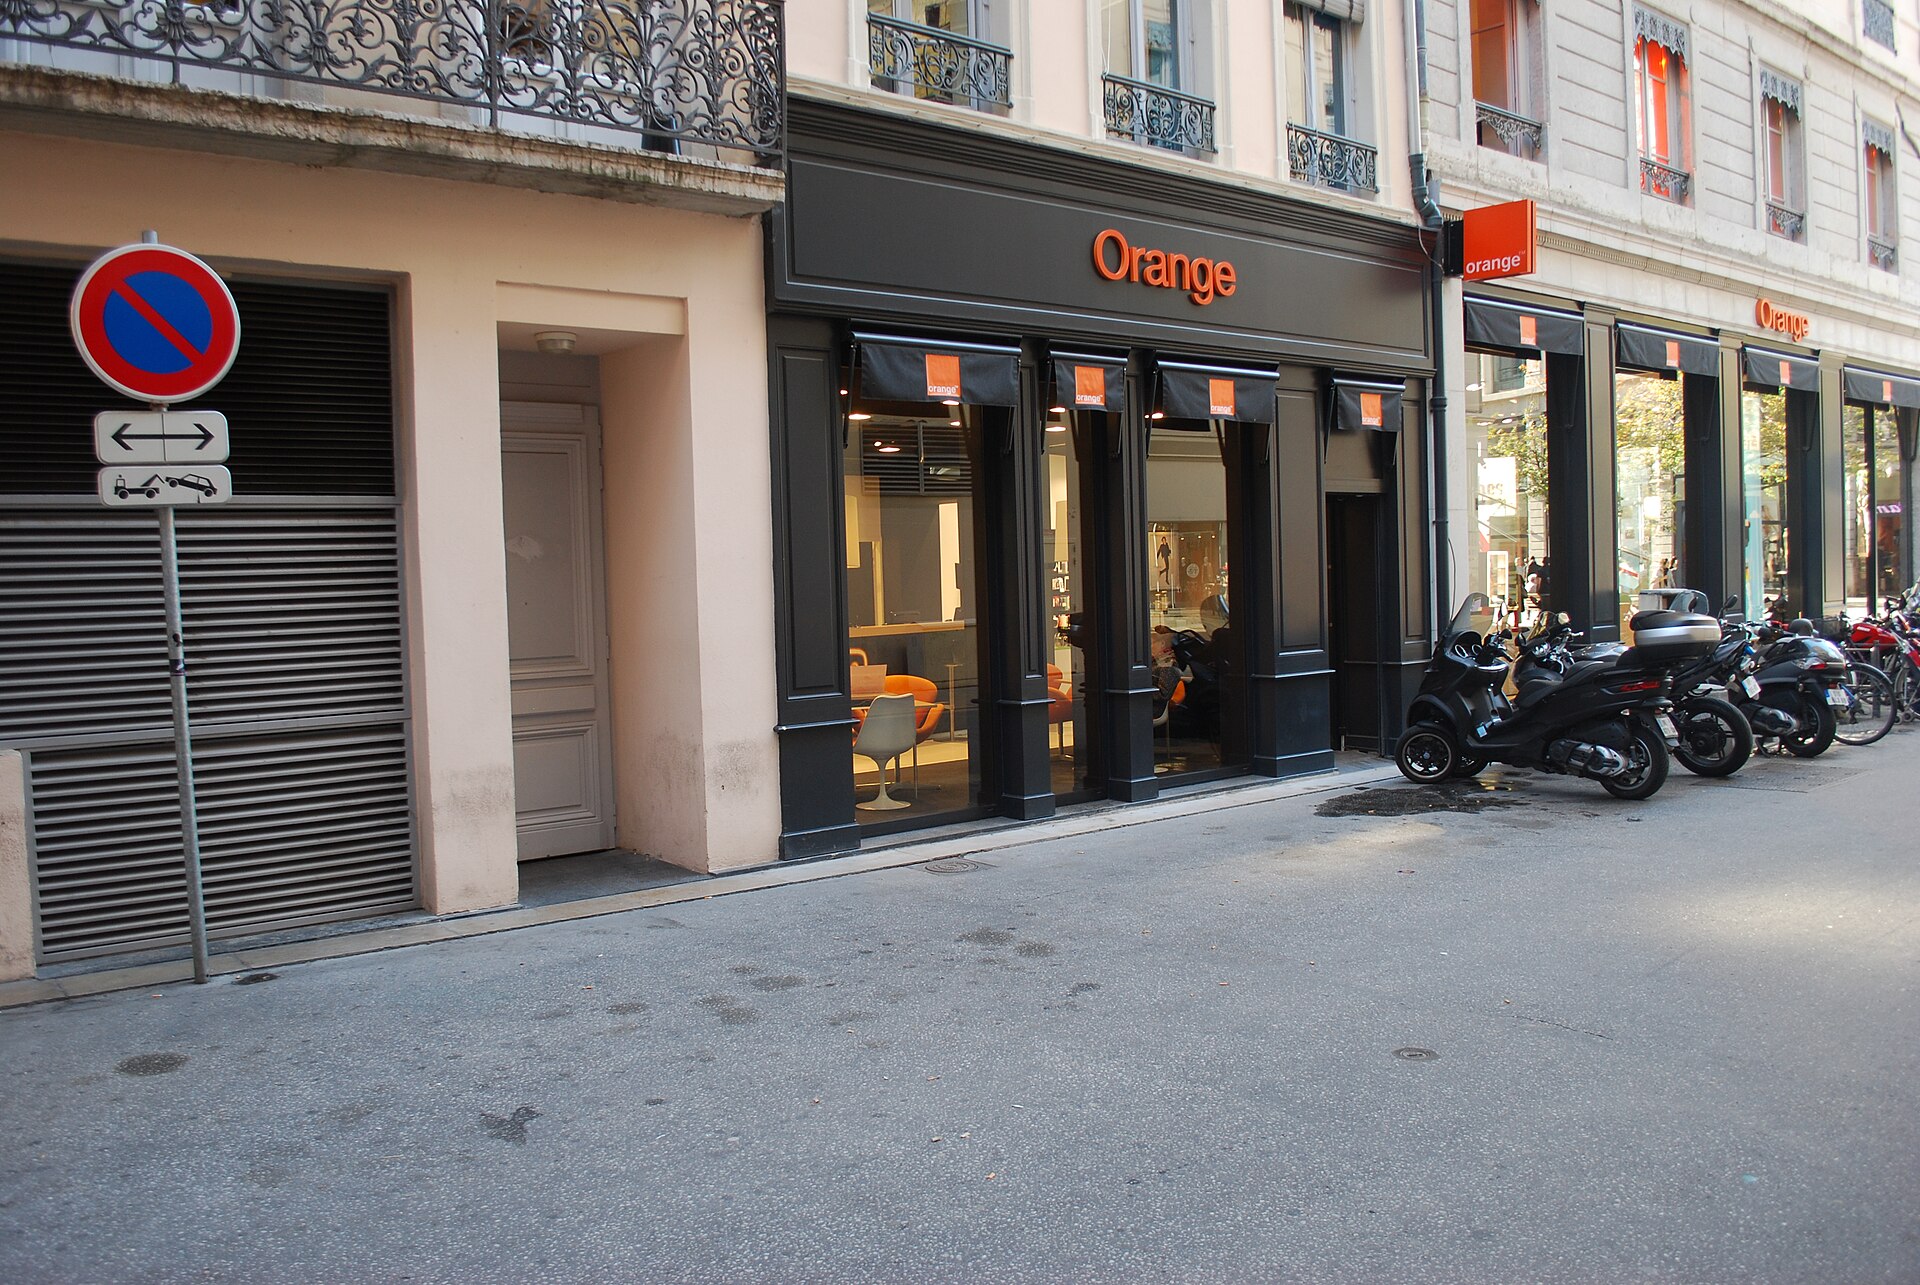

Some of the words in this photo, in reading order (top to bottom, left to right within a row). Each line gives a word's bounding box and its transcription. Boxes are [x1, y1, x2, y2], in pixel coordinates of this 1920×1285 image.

[1094, 228, 1236, 305] Orange
[1466, 255, 1520, 273] orange
[1755, 298, 1809, 342] Orange
[928, 385, 957, 396] orange
[1076, 395, 1102, 403] orange
